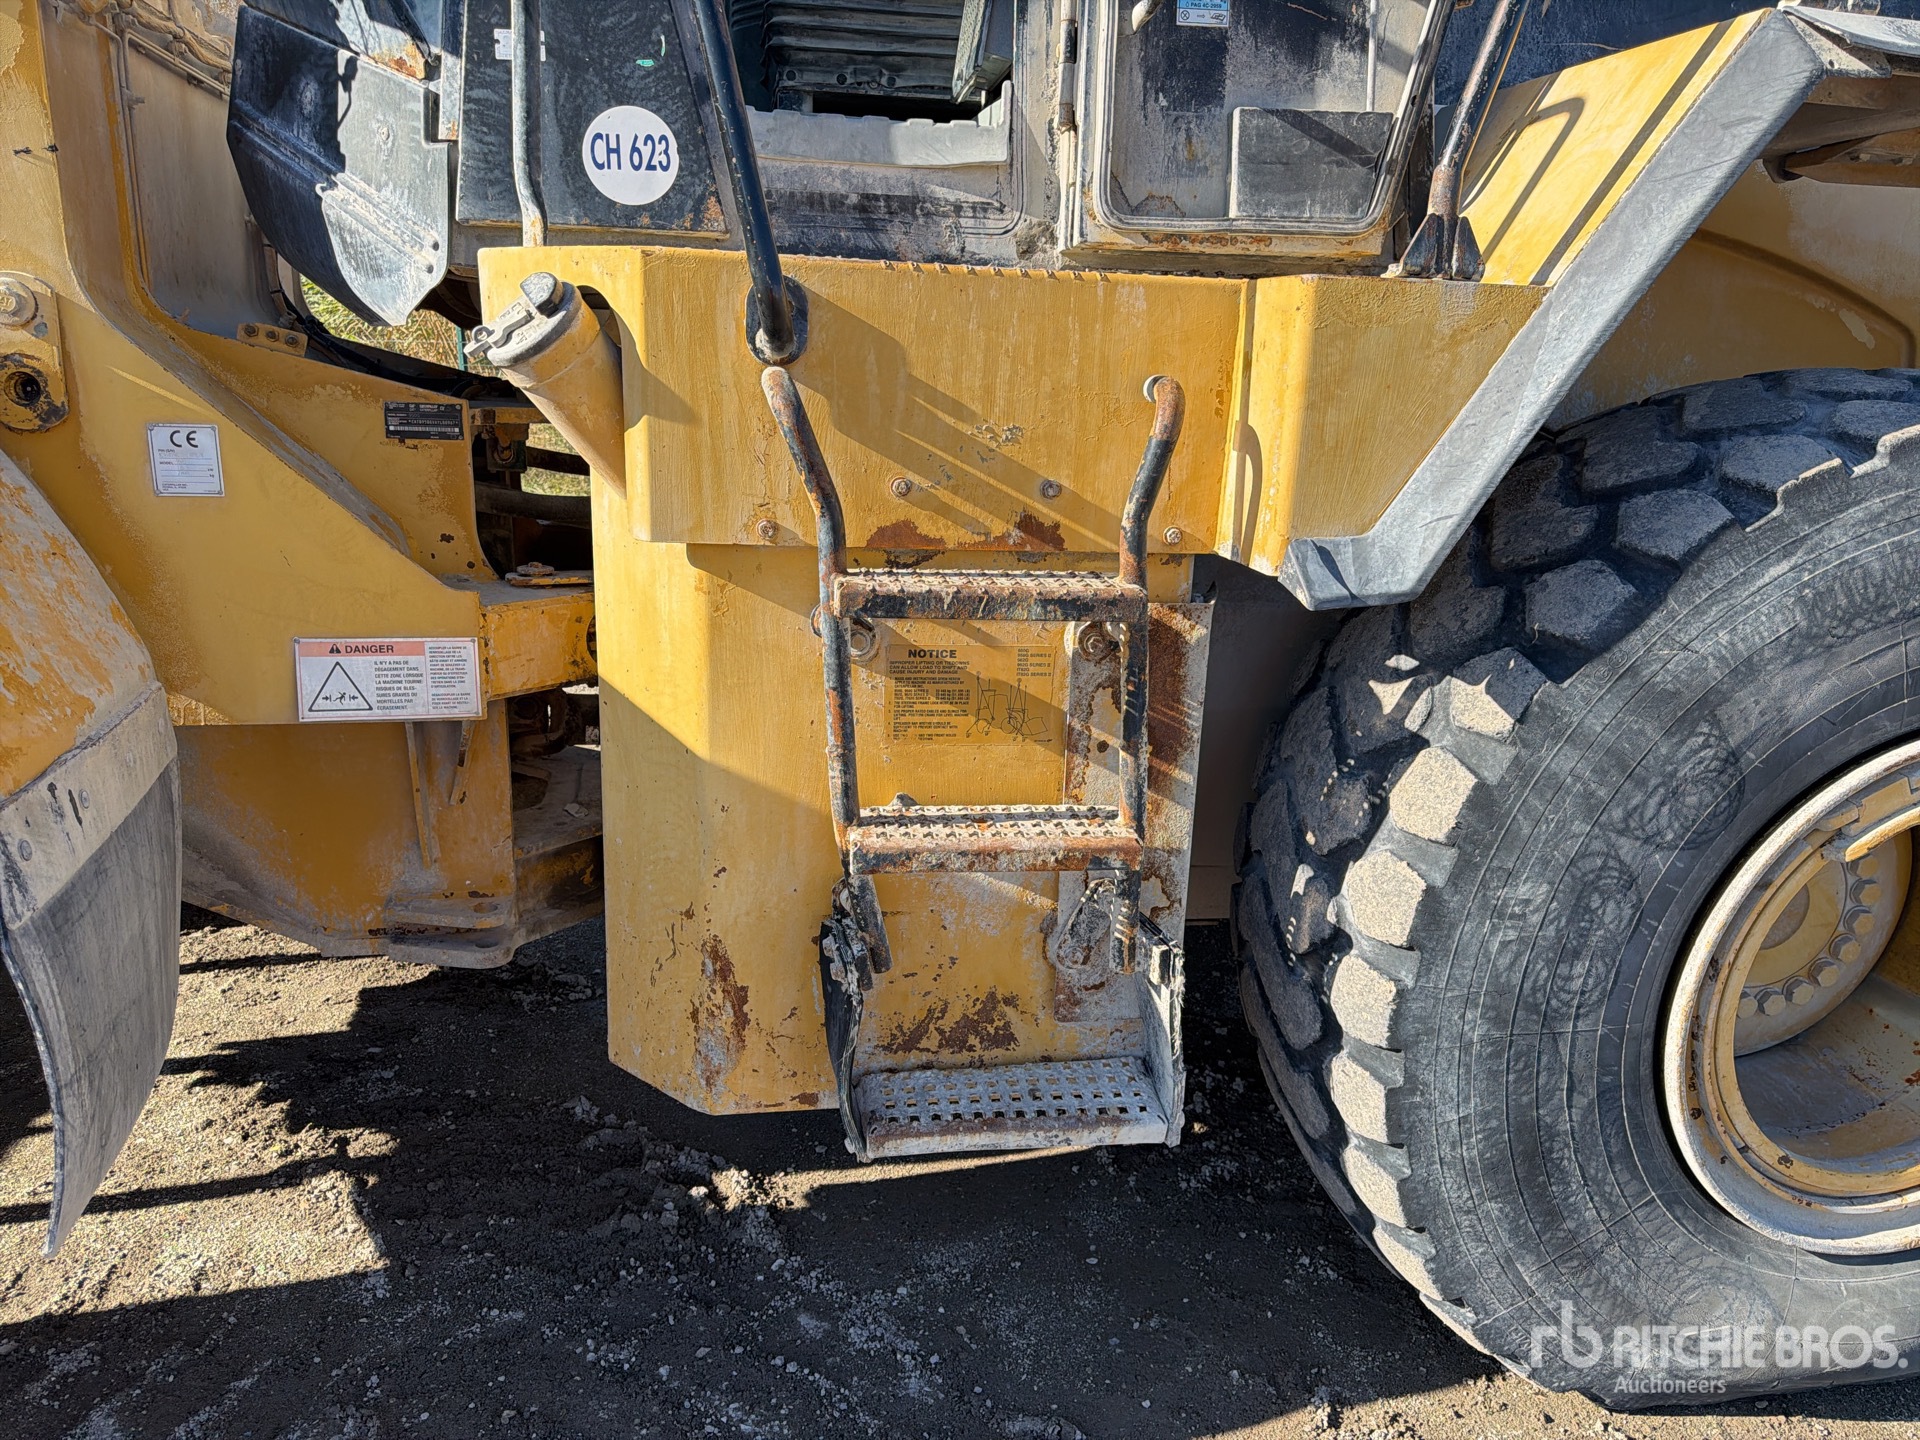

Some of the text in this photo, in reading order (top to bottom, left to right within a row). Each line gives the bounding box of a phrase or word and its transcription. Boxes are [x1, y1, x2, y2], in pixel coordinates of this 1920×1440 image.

[590, 132, 671, 172] CH 623
[170, 430, 198, 448] CE
[345, 645, 394, 654] DANGER
[908, 650, 957, 658] NOTICE
